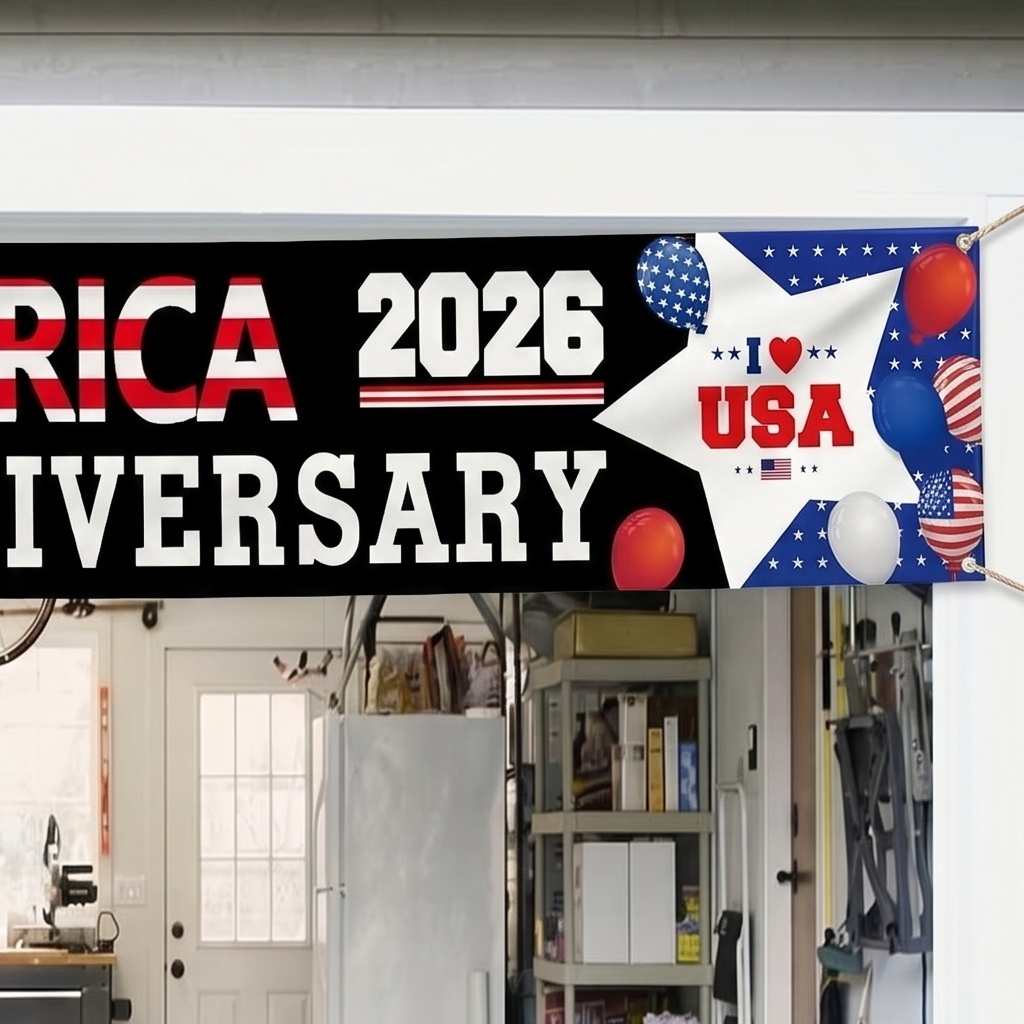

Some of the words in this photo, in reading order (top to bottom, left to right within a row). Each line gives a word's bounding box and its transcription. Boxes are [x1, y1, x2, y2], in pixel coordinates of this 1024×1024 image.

[358, 269, 604, 378] 2026
[746, 336, 762, 374] I
[698, 384, 854, 449] USA
